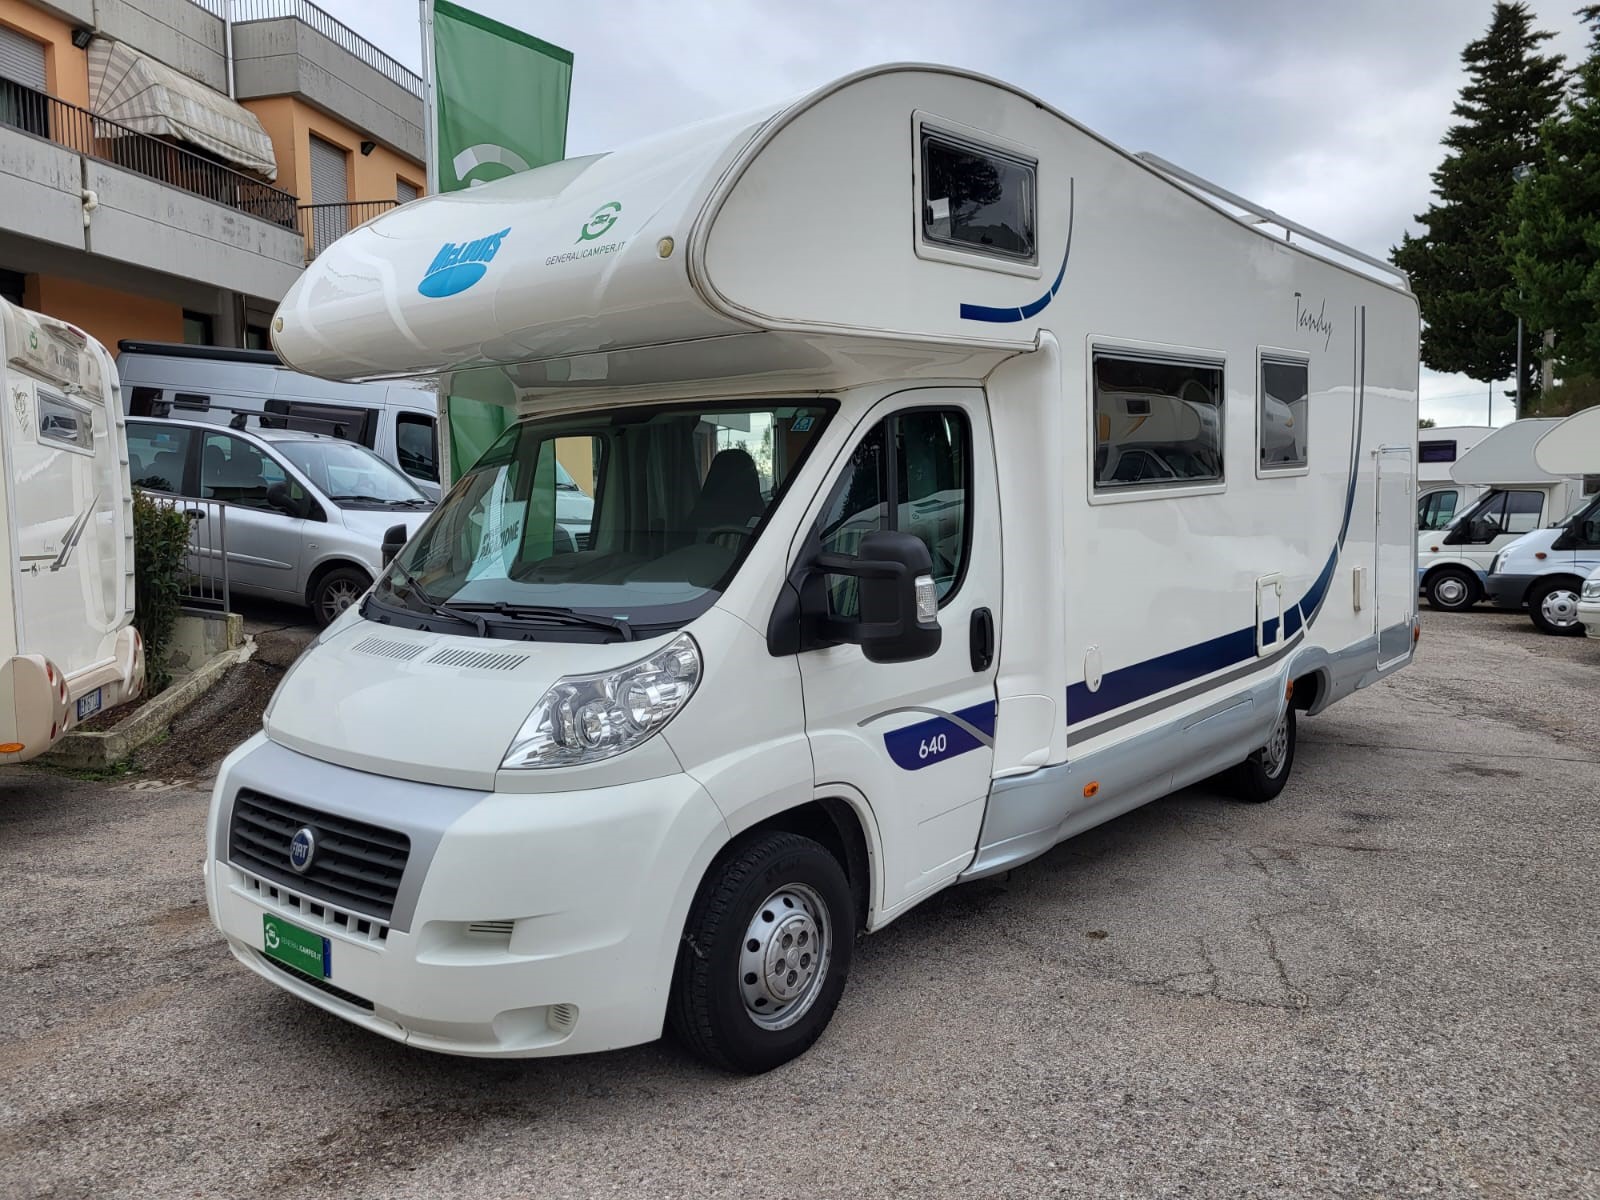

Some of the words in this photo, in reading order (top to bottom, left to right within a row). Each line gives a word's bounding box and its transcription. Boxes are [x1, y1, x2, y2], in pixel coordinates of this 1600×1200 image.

[545, 241, 626, 266] GENERALICAMPER.IT
[919, 733, 947, 759] 640
[293, 841, 308, 859] FIAT
